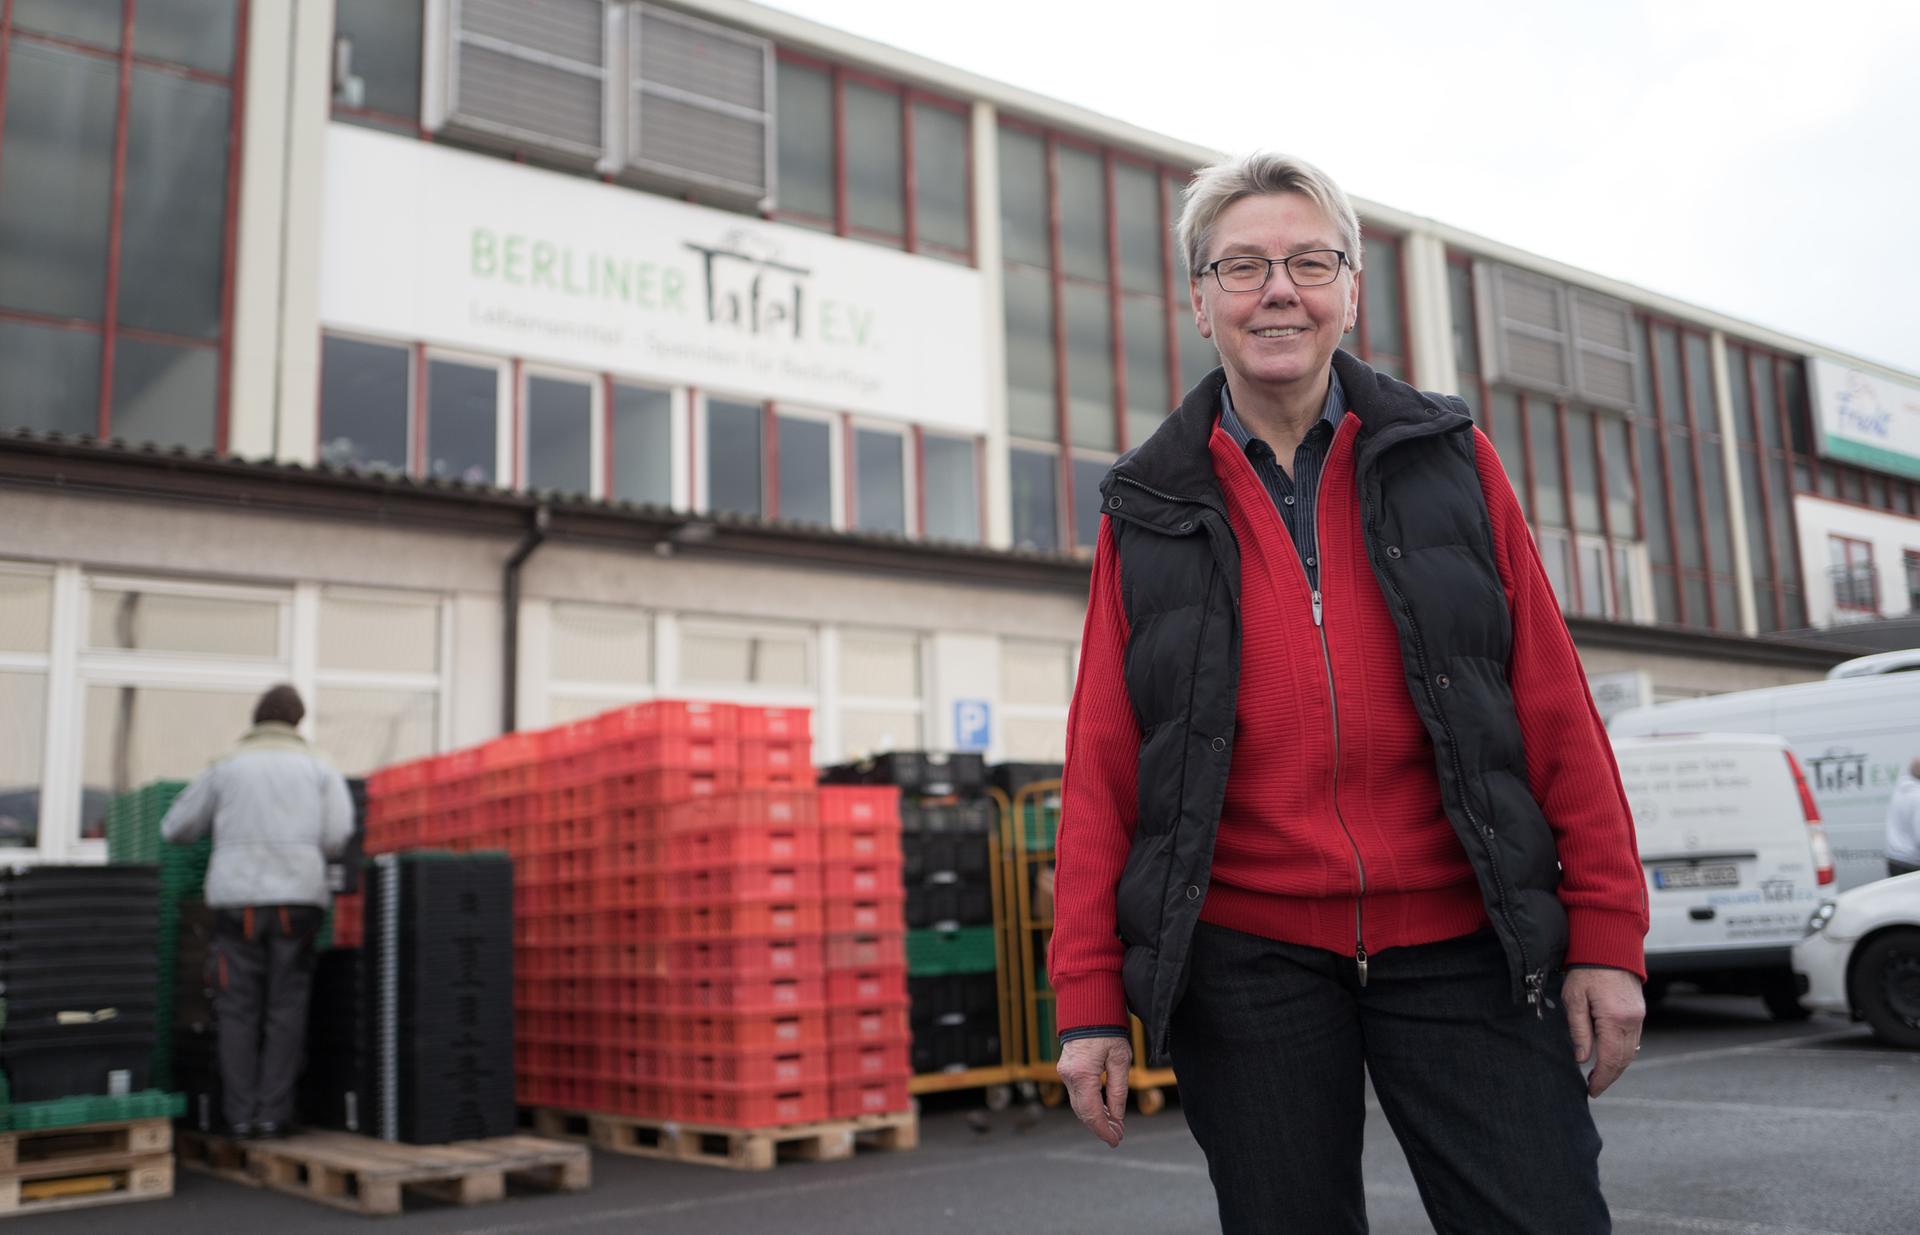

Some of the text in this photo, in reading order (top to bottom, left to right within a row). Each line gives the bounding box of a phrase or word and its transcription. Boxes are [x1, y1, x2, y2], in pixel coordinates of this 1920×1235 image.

[471, 229, 687, 313] BERLINER
[684, 242, 811, 339] Tafel
[960, 702, 985, 743] P
